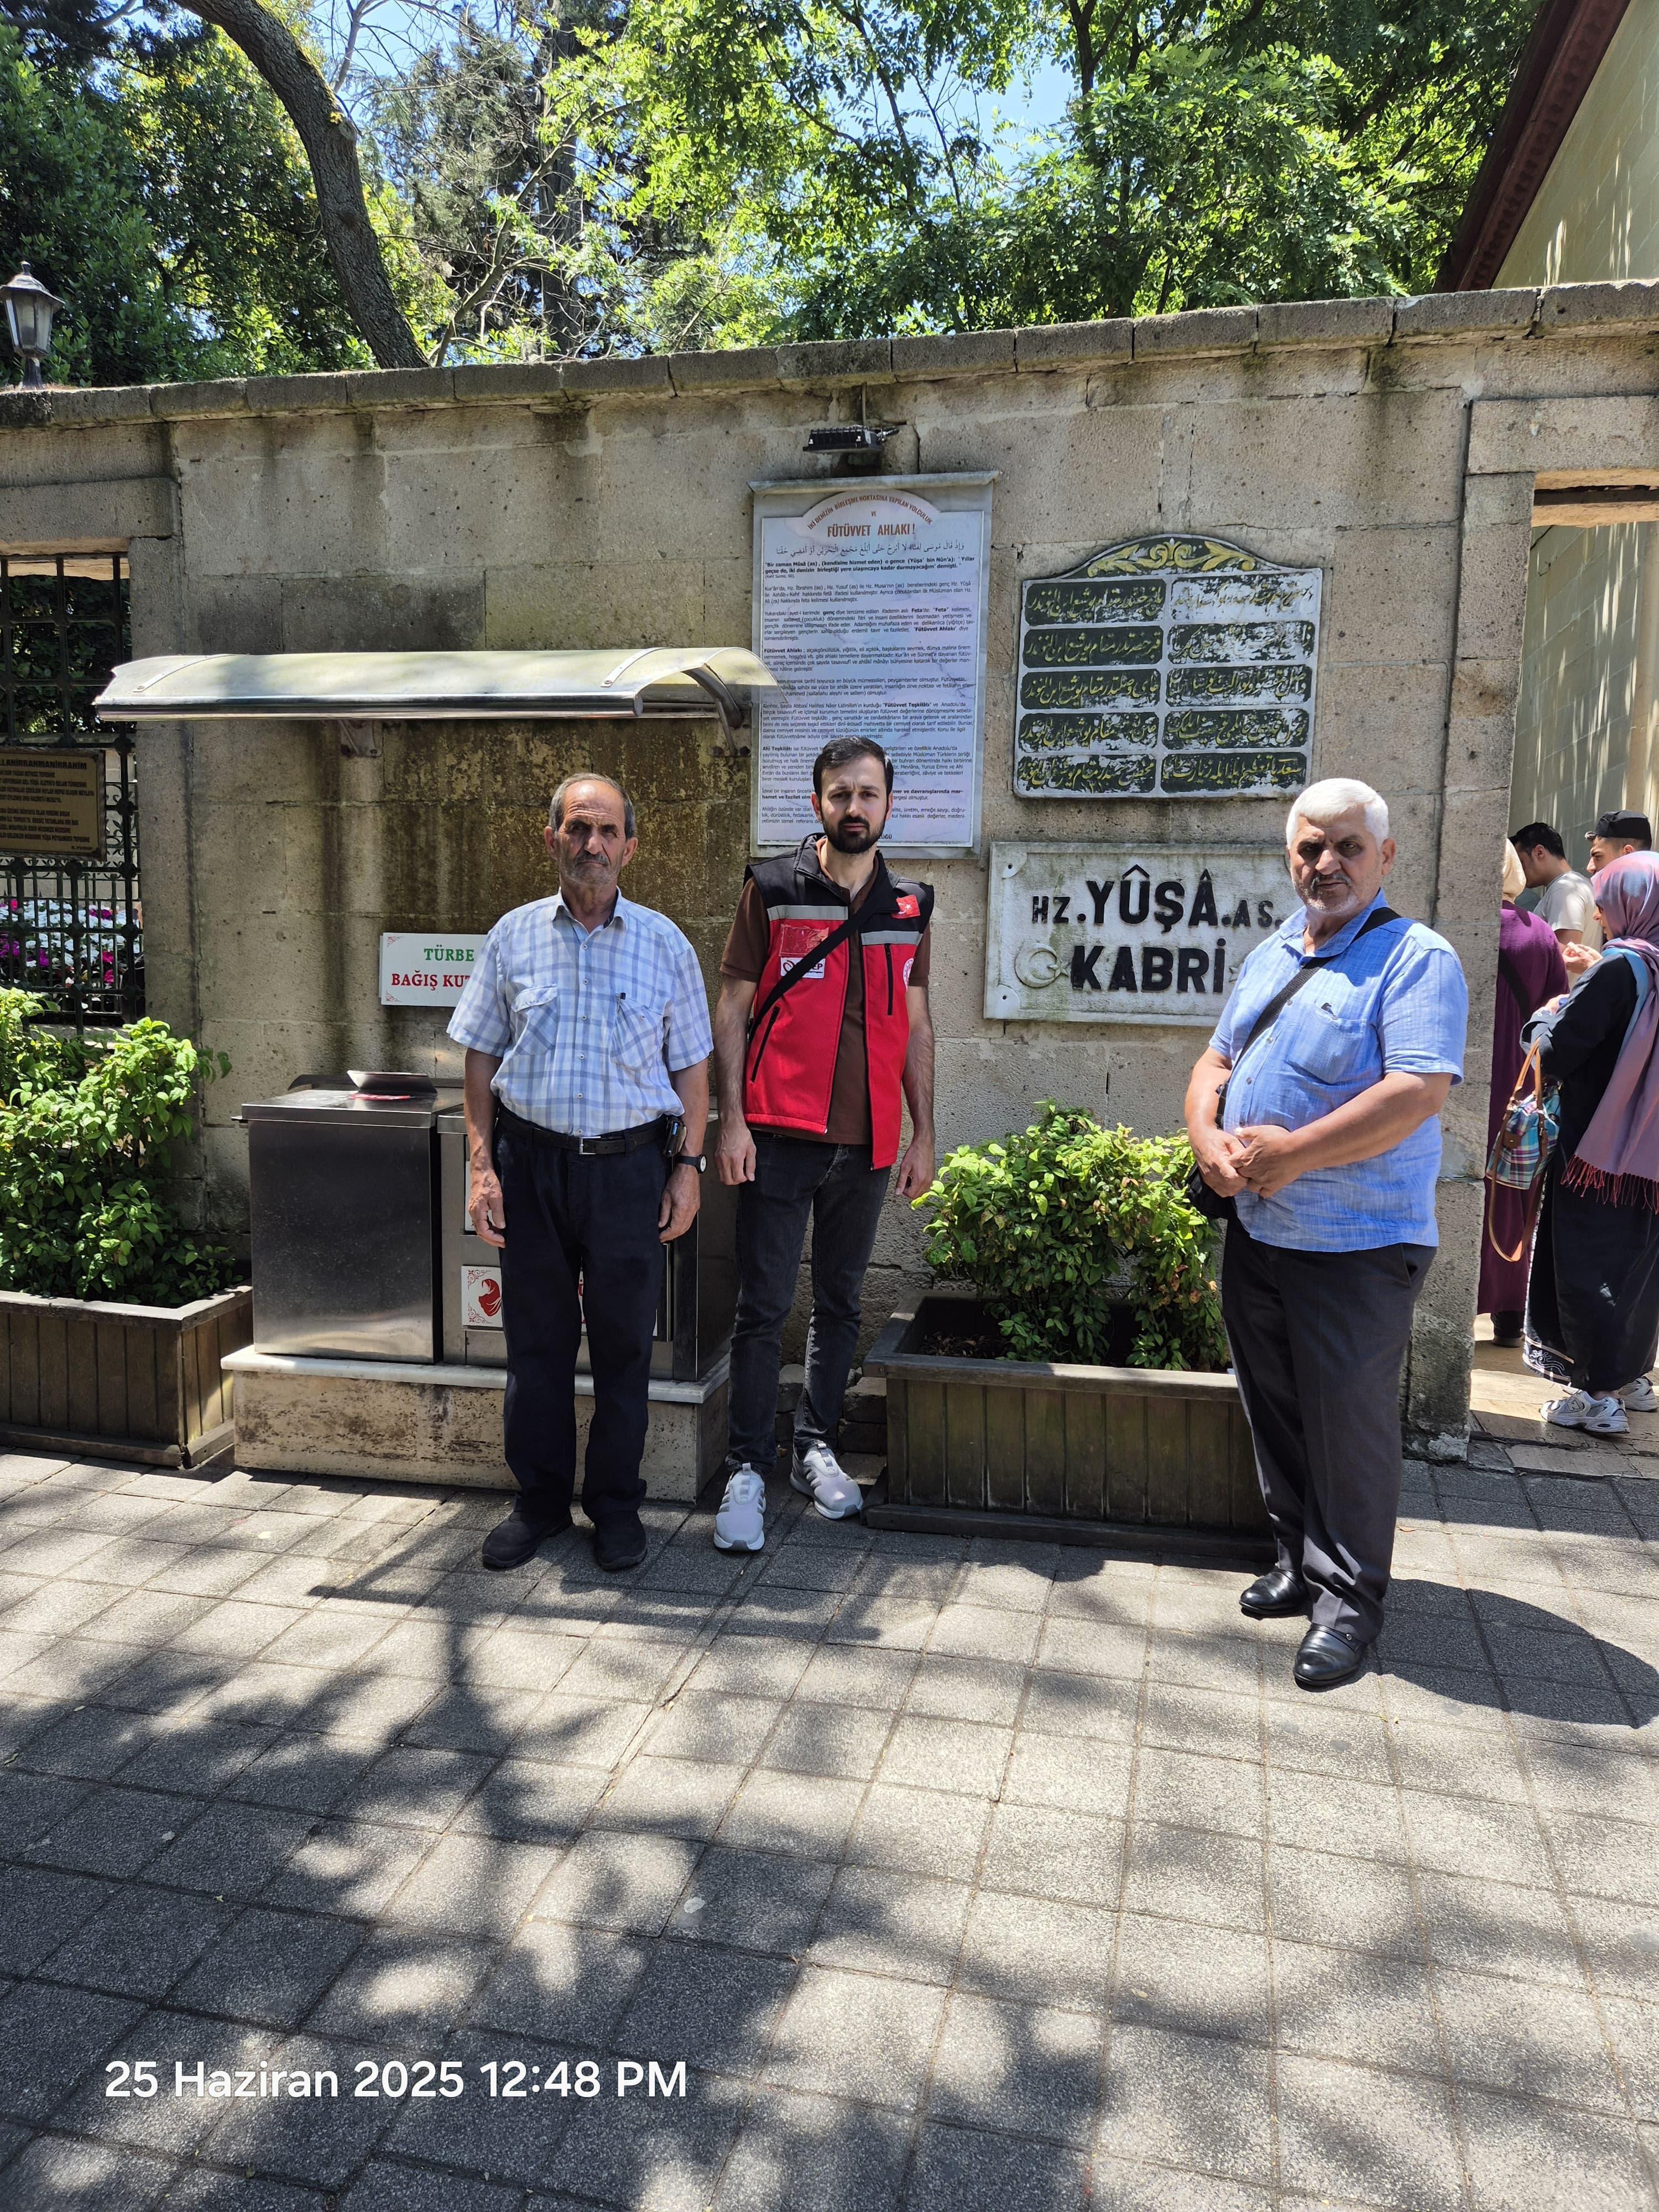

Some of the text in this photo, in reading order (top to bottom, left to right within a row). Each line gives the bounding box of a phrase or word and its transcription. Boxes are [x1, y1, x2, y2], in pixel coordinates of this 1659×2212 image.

[815, 508, 833, 524] DENİZİN
[834, 497, 859, 510] BİRLEŞME
[889, 496, 909, 508] YAPILAN
[909, 504, 933, 525] YOLCULUK
[827, 523, 871, 538] FÜTÜVVET
[878, 524, 910, 536] AHLAKI
[424, 945, 474, 961] TÜRBE
[1070, 938, 1226, 993] KABRİ
[392, 969, 438, 990] BAĞIŞ
